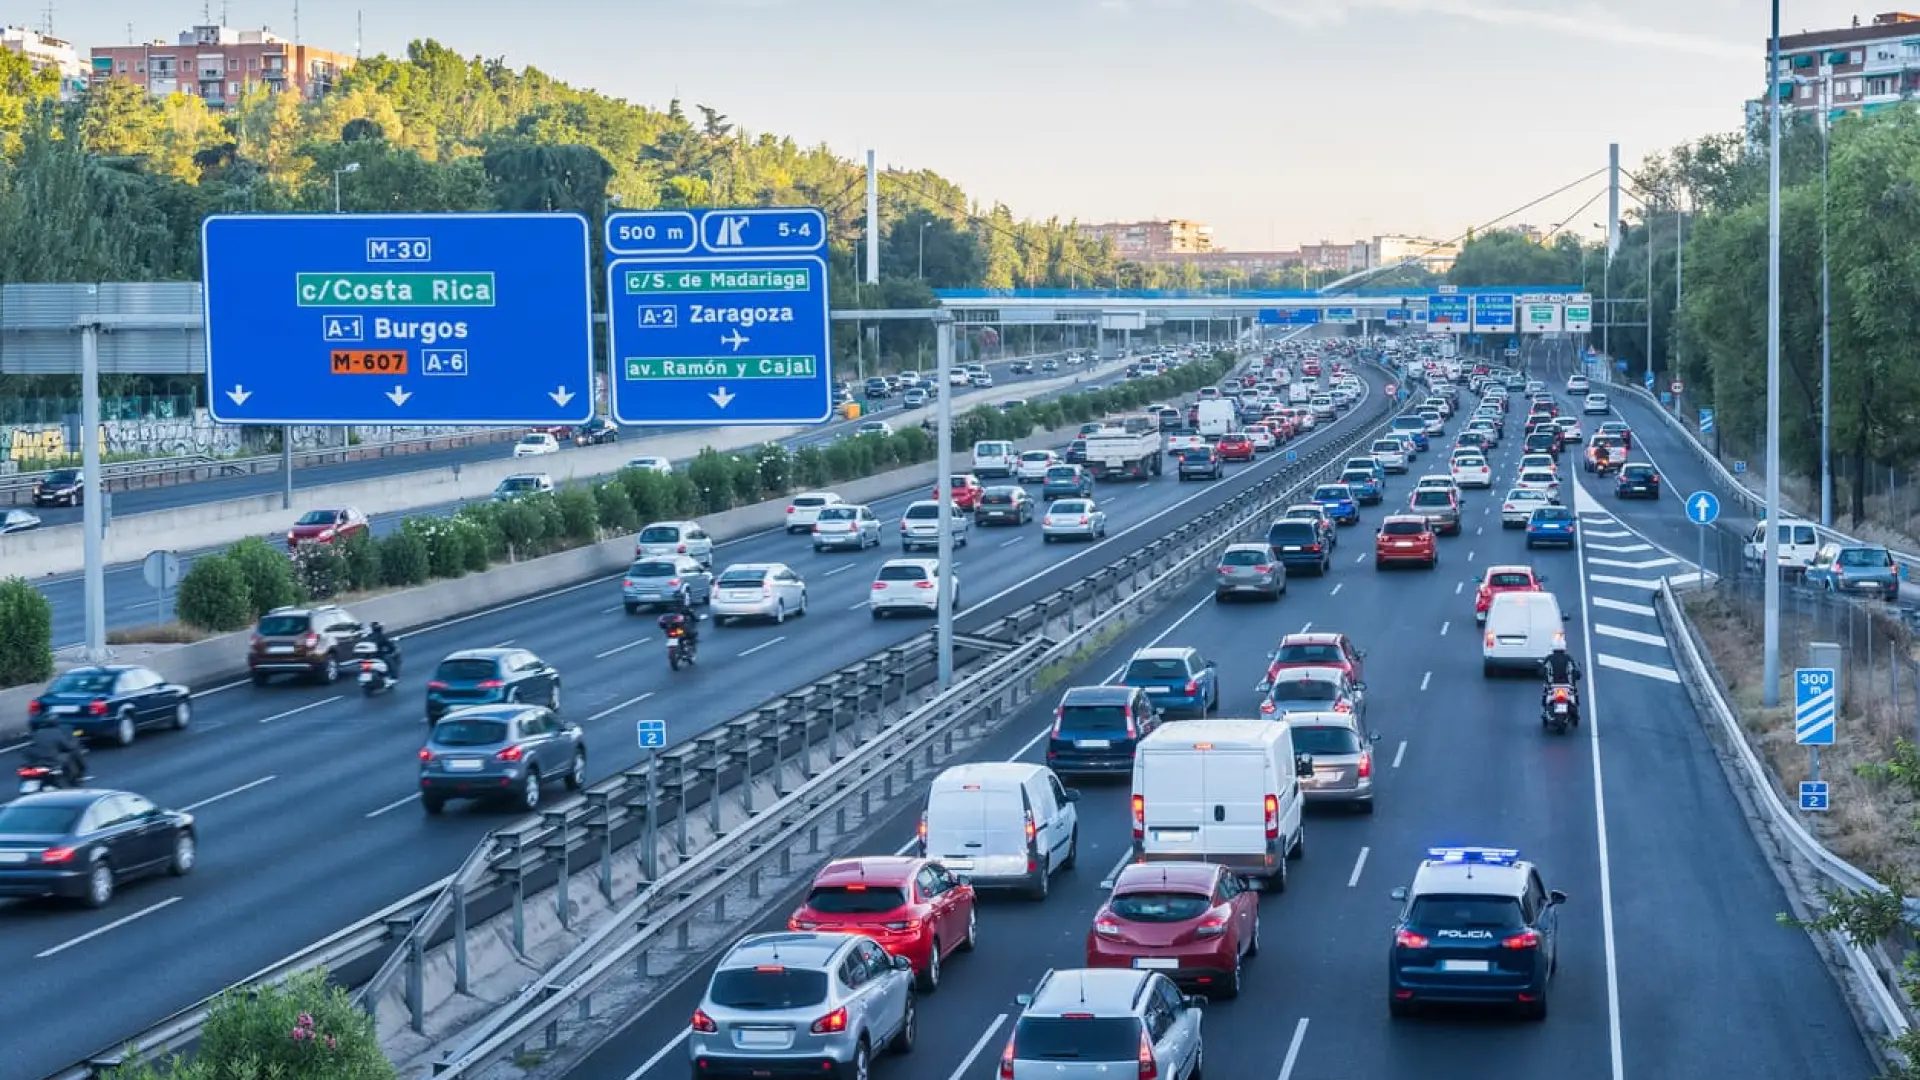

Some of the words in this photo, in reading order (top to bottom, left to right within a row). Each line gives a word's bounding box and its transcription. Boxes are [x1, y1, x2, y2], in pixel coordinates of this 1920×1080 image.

[620, 224, 656, 241] 500
[667, 227, 684, 240] m
[778, 222, 811, 237] 5-4
[371, 241, 427, 259] M-30
[303, 278, 413, 300] c/Costa
[432, 279, 491, 301] Rica
[629, 273, 672, 288] c/S.
[679, 273, 702, 288] de
[711, 272, 806, 291] Madariaga
[643, 308, 674, 324] A-2
[690, 305, 793, 326] Zaragoza
[328, 319, 359, 337] A-1
[374, 317, 468, 344] Burgos
[333, 353, 405, 371] M-607
[426, 353, 463, 371] A-6
[629, 362, 656, 375] av.
[662, 359, 728, 375] Ramón
[736, 362, 747, 378] y
[758, 358, 813, 377] Cajal
[1801, 673, 1829, 686] 300
[1810, 686, 1821, 695] m
[647, 732, 657, 744] 2
[1809, 796, 1819, 807] 2
